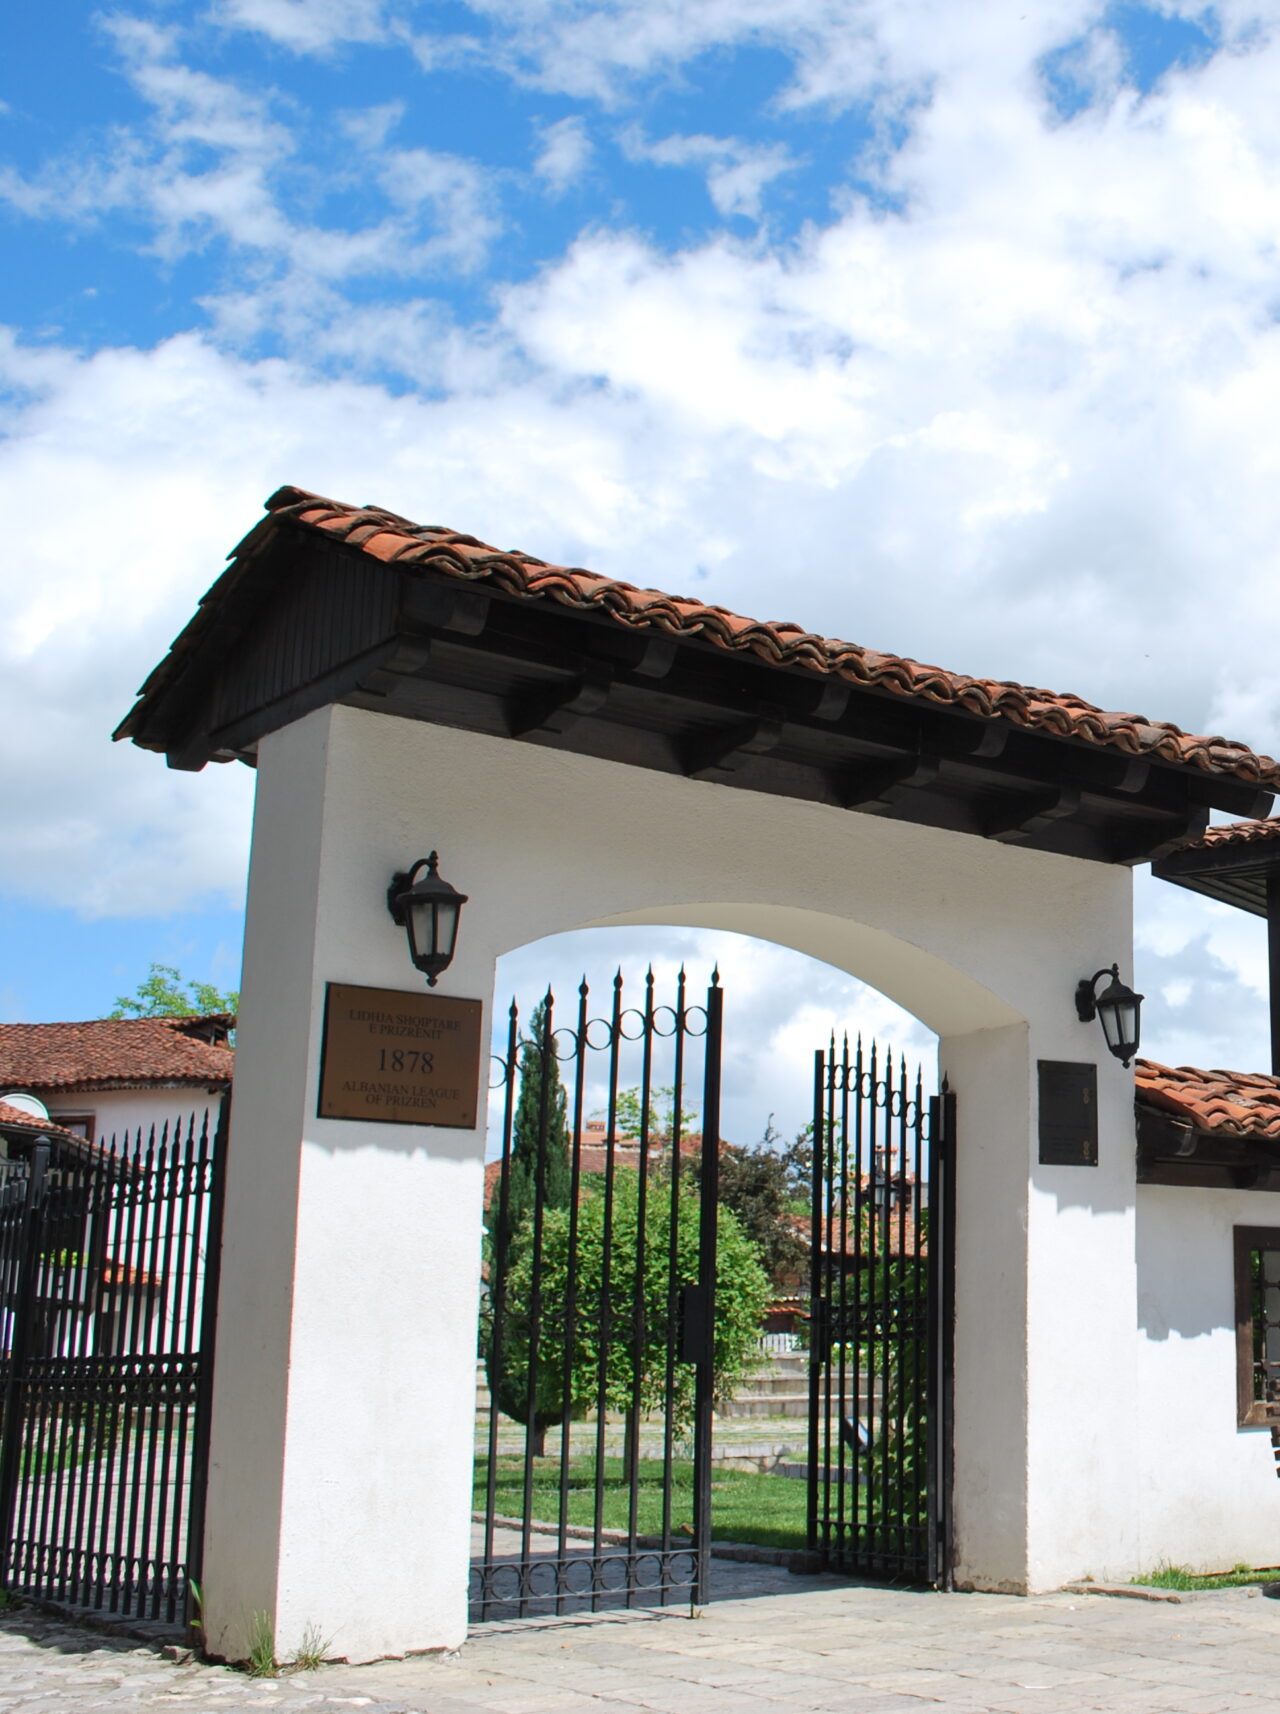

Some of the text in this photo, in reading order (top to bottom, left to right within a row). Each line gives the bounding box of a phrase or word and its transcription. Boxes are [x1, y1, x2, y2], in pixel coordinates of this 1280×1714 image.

[369, 1024, 442, 1040] E PRIZRENIT
[378, 1048, 434, 1074] 1878
[342, 1080, 460, 1100] ALBANIAN LEAGUE
[366, 1094, 436, 1108] OF PRIZREN
